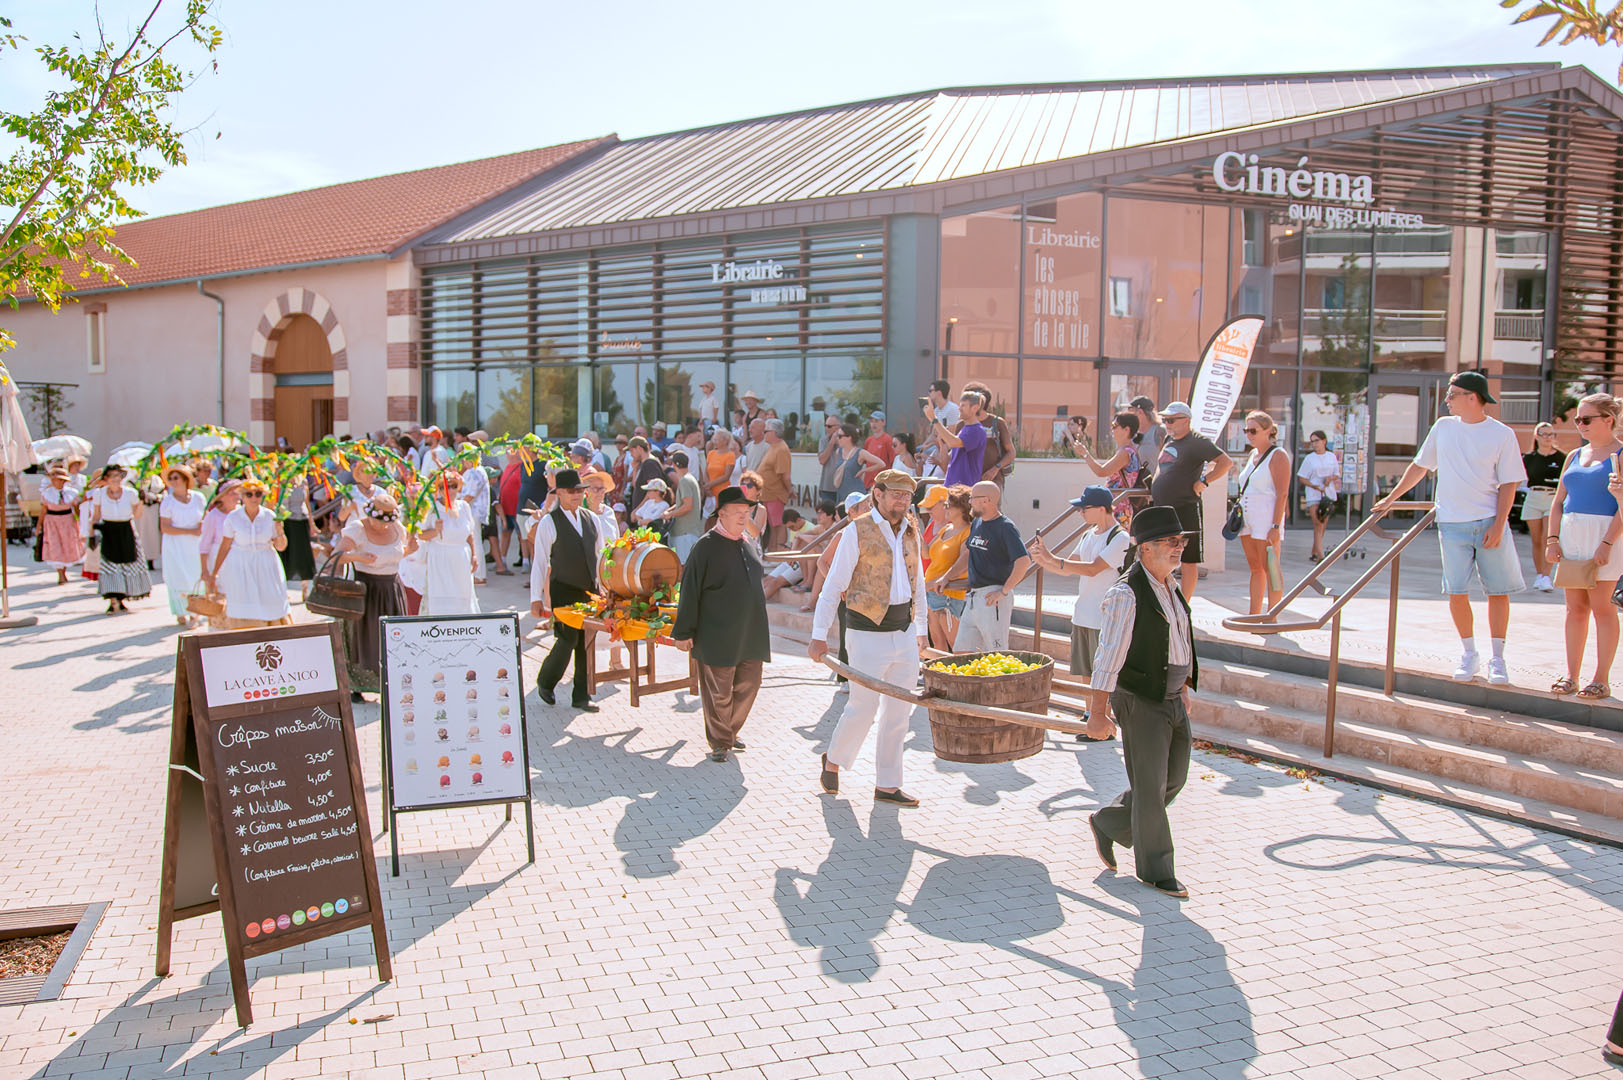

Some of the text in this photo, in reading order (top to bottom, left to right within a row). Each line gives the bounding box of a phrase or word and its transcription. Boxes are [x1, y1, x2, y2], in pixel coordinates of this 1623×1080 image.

[1213, 151, 1375, 203] Cinéma
[1288, 204, 1424, 229] QUAI DES LUMIÈRES
[1028, 226, 1101, 248] Librairie
[711, 259, 784, 283] Librairie
[1035, 252, 1055, 283] les
[1034, 285, 1079, 317] choses
[1033, 317, 1089, 349] de la vie
[224, 679, 241, 691] LA
[242, 675, 276, 688] CAVE
[287, 670, 319, 682] NICO
[218, 719, 323, 749] Crêpes maison
[248, 800, 292, 816] Nutella
[286, 819, 297, 829] de
